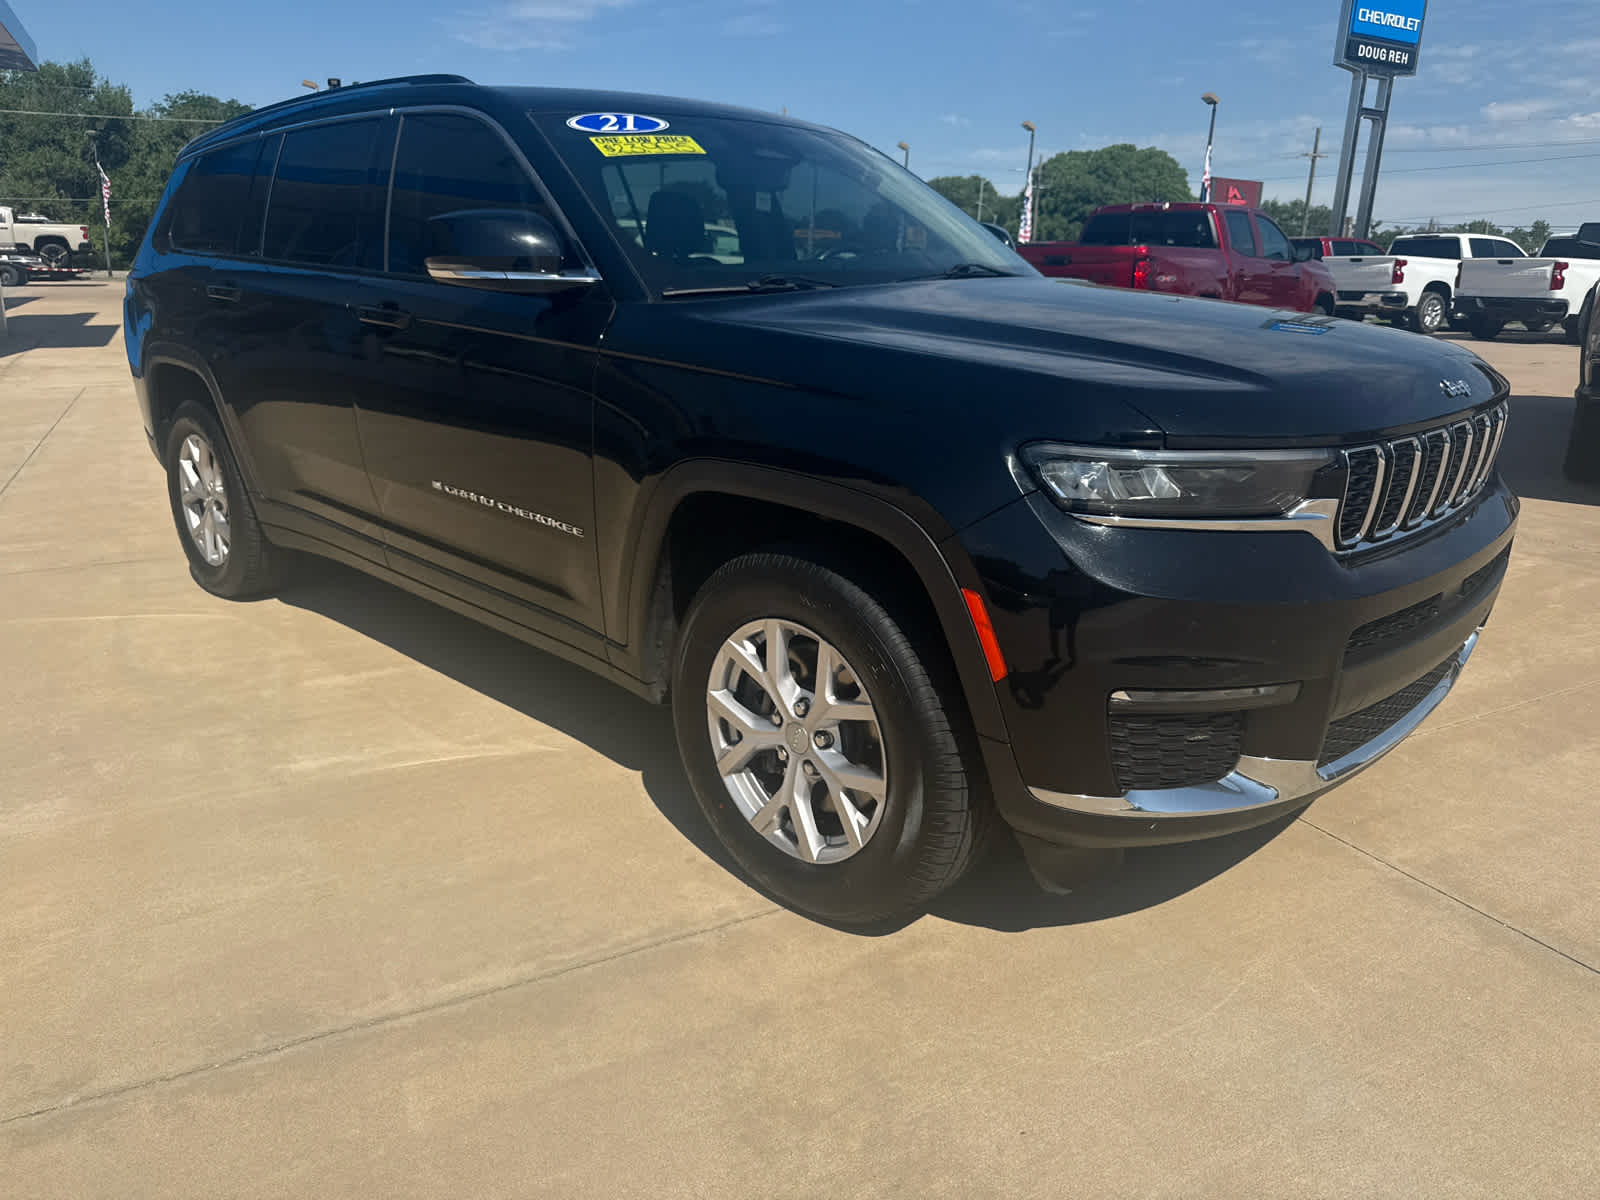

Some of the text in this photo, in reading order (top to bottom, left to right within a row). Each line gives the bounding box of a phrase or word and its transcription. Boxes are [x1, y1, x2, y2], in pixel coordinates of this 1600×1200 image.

[1358, 8, 1420, 31] CHEVROLET
[1358, 44, 1409, 65] DOUG REH
[599, 115, 639, 131] 21
[595, 135, 690, 144] ONE LOW PRICE
[497, 502, 585, 538] CHEROKEE
